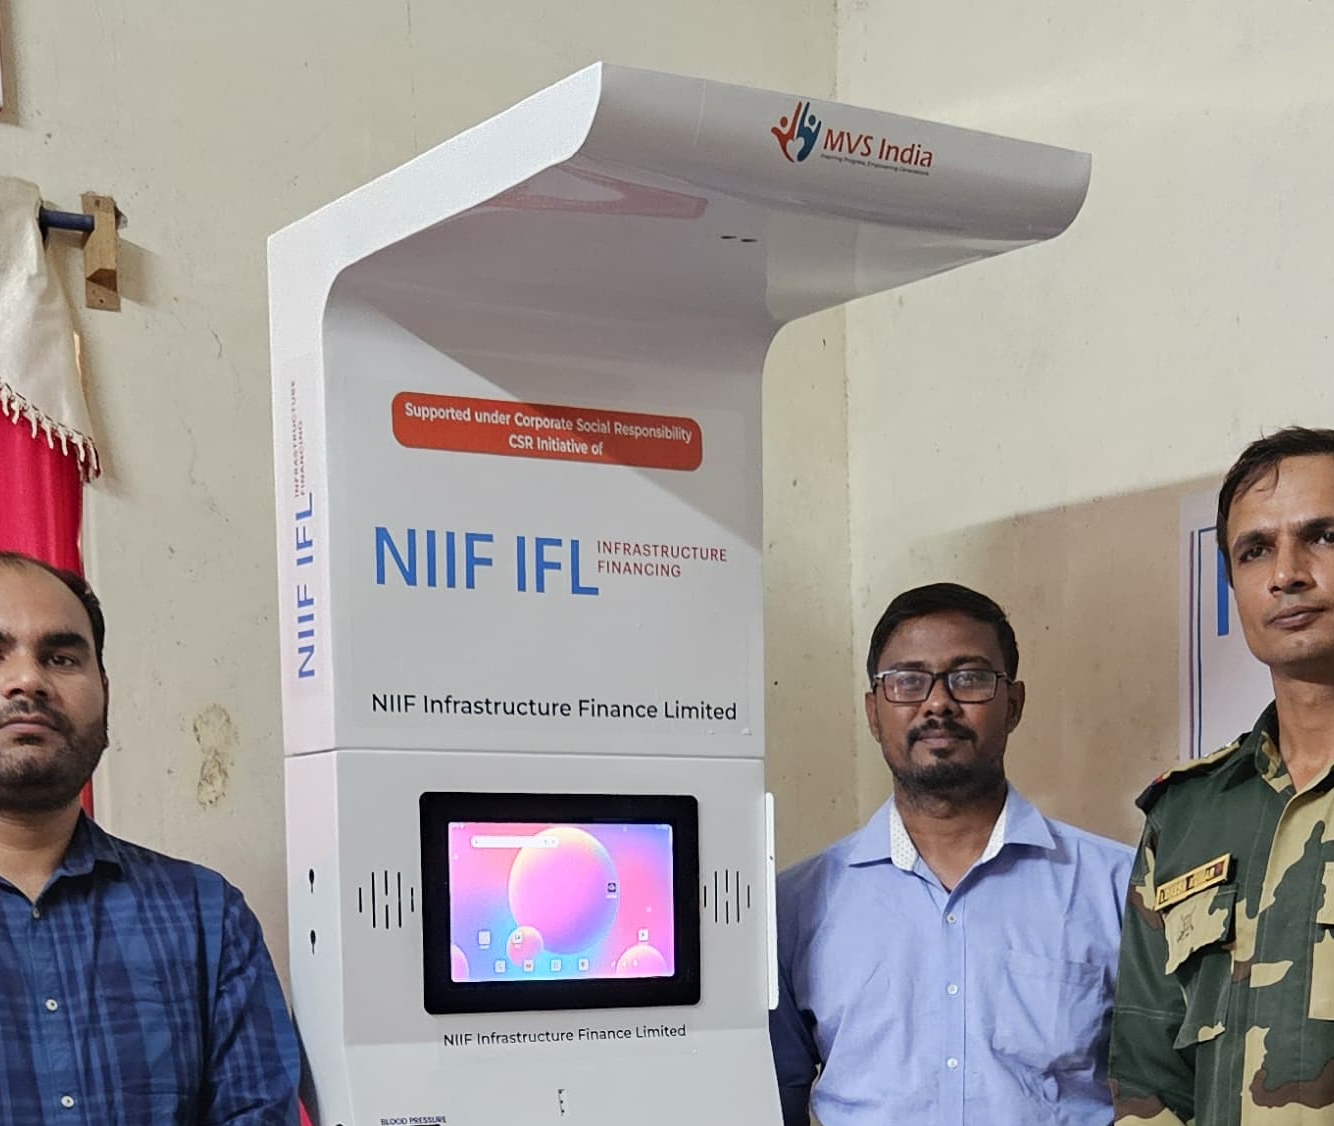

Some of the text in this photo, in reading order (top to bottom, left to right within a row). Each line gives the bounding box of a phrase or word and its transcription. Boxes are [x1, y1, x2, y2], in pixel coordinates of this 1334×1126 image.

[823, 128, 934, 168] MVS India
[405, 403, 693, 444] Supported under Corporate Social Responsibility
[508, 434, 604, 455] CSR Initiative of
[374, 526, 600, 596] NIIF IFL
[596, 540, 728, 563] INFRASTRUCTURE
[597, 560, 682, 578] FINANCING
[295, 492, 315, 679] NIIF IFL
[371, 693, 738, 720] NIIF Infrastructure Finance Limited
[443, 1023, 687, 1047] NIIF Infrastructure Finance Limited
[380, 1115, 447, 1126] BLOOD PRESSURE
